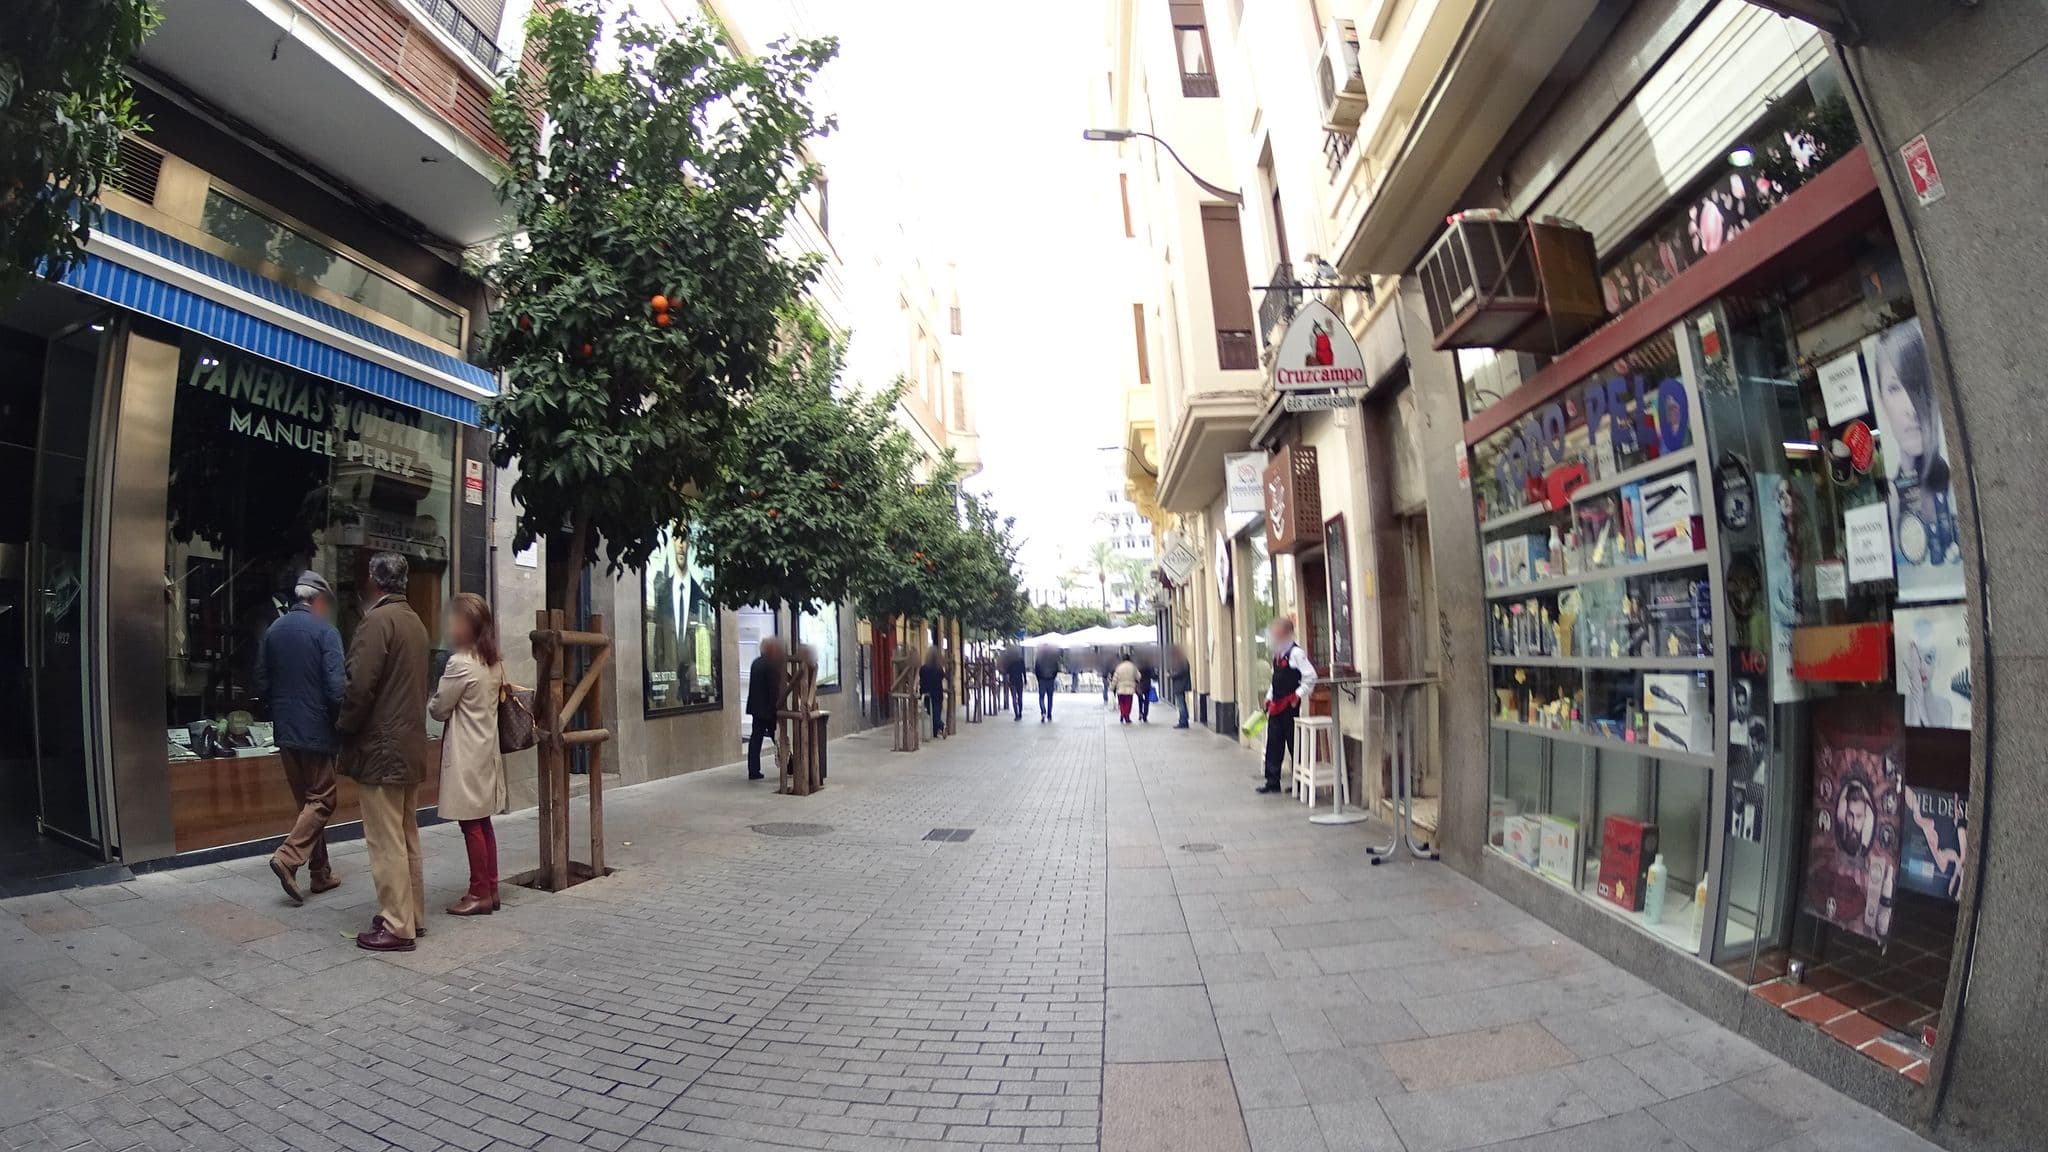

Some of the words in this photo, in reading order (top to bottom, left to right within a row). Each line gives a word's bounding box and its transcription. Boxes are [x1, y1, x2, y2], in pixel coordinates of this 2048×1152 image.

[1277, 367, 1364, 384] Cruzcampo
[229, 407, 337, 457] MANUEL
[346, 439, 416, 479] PEREZ
[1584, 375, 1689, 451] PELO
